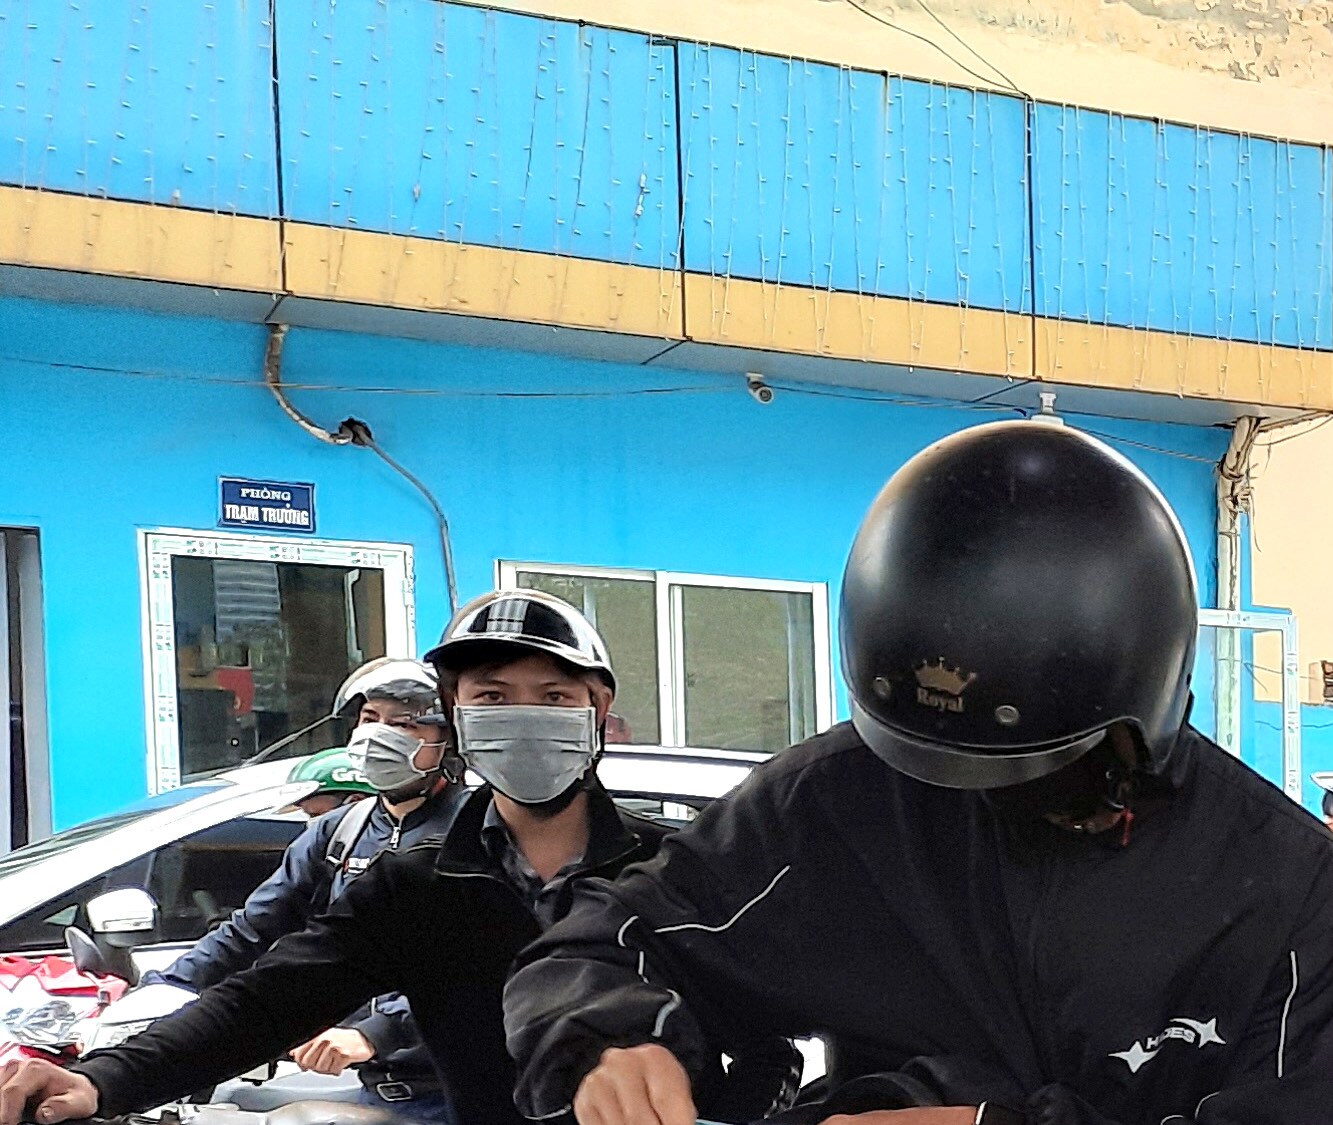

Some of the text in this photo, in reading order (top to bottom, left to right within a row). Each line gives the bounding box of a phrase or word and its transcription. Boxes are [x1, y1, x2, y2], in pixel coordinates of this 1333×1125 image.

[240, 486, 291, 501] PHÒNG
[224, 504, 260, 524] TRẠM
[917, 687, 964, 713] Royal
